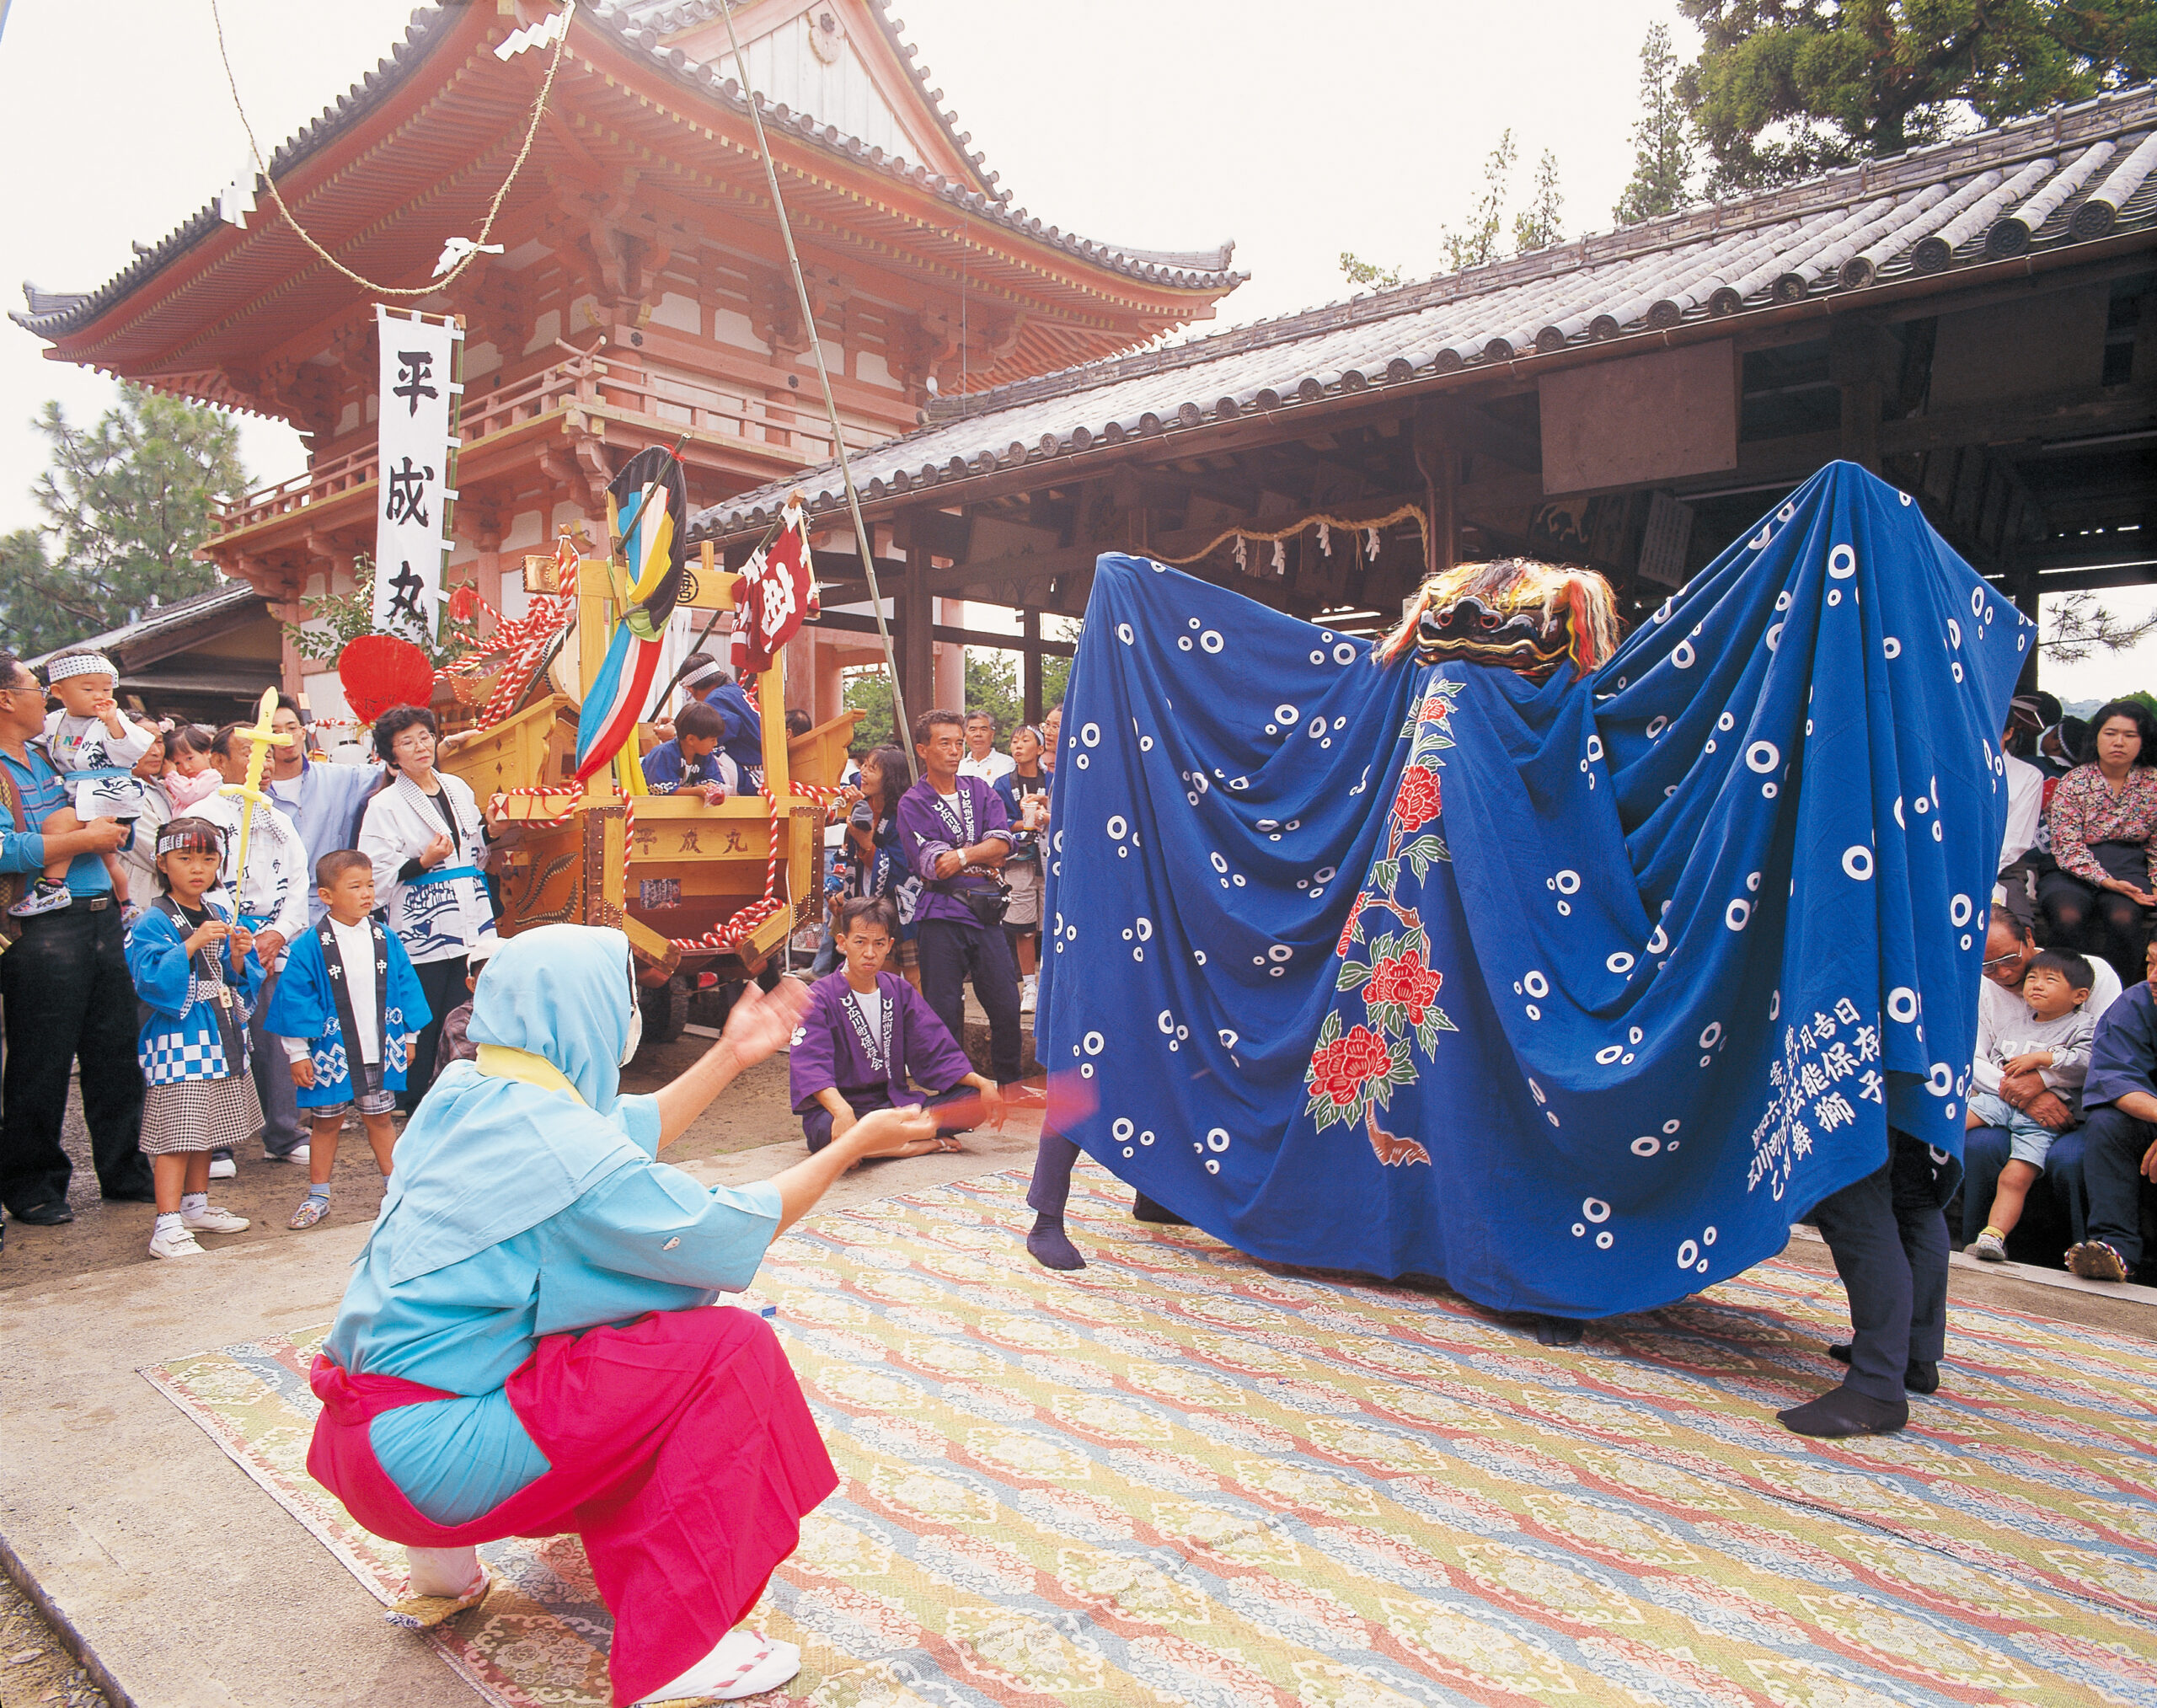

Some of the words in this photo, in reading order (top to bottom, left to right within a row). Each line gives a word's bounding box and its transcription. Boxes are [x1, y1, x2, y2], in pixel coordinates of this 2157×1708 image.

[383, 350, 439, 624] 平成丸
[634, 827, 749, 855] 平成丸
[320, 931, 342, 980] 東中
[372, 926, 388, 975] 東中
[846, 1005, 884, 1071] 広川町保存会
